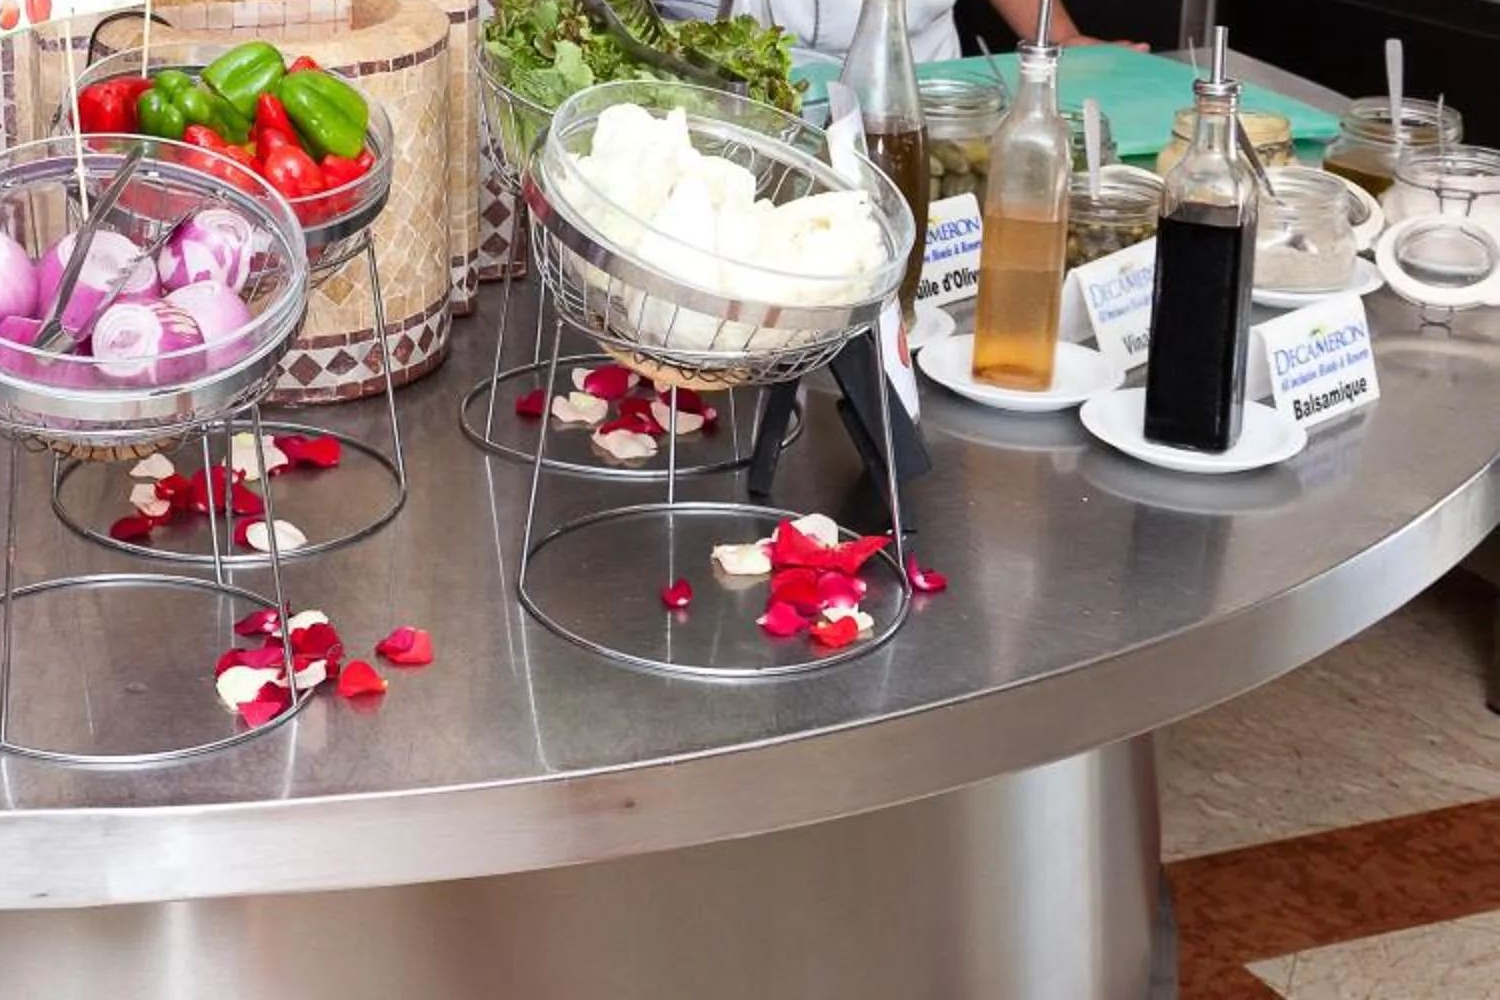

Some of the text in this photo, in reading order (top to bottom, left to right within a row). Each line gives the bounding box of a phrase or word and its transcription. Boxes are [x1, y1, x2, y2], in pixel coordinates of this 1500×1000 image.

[917, 267, 980, 299] uile d'Oliv
[1292, 376, 1368, 421] Balsamique
